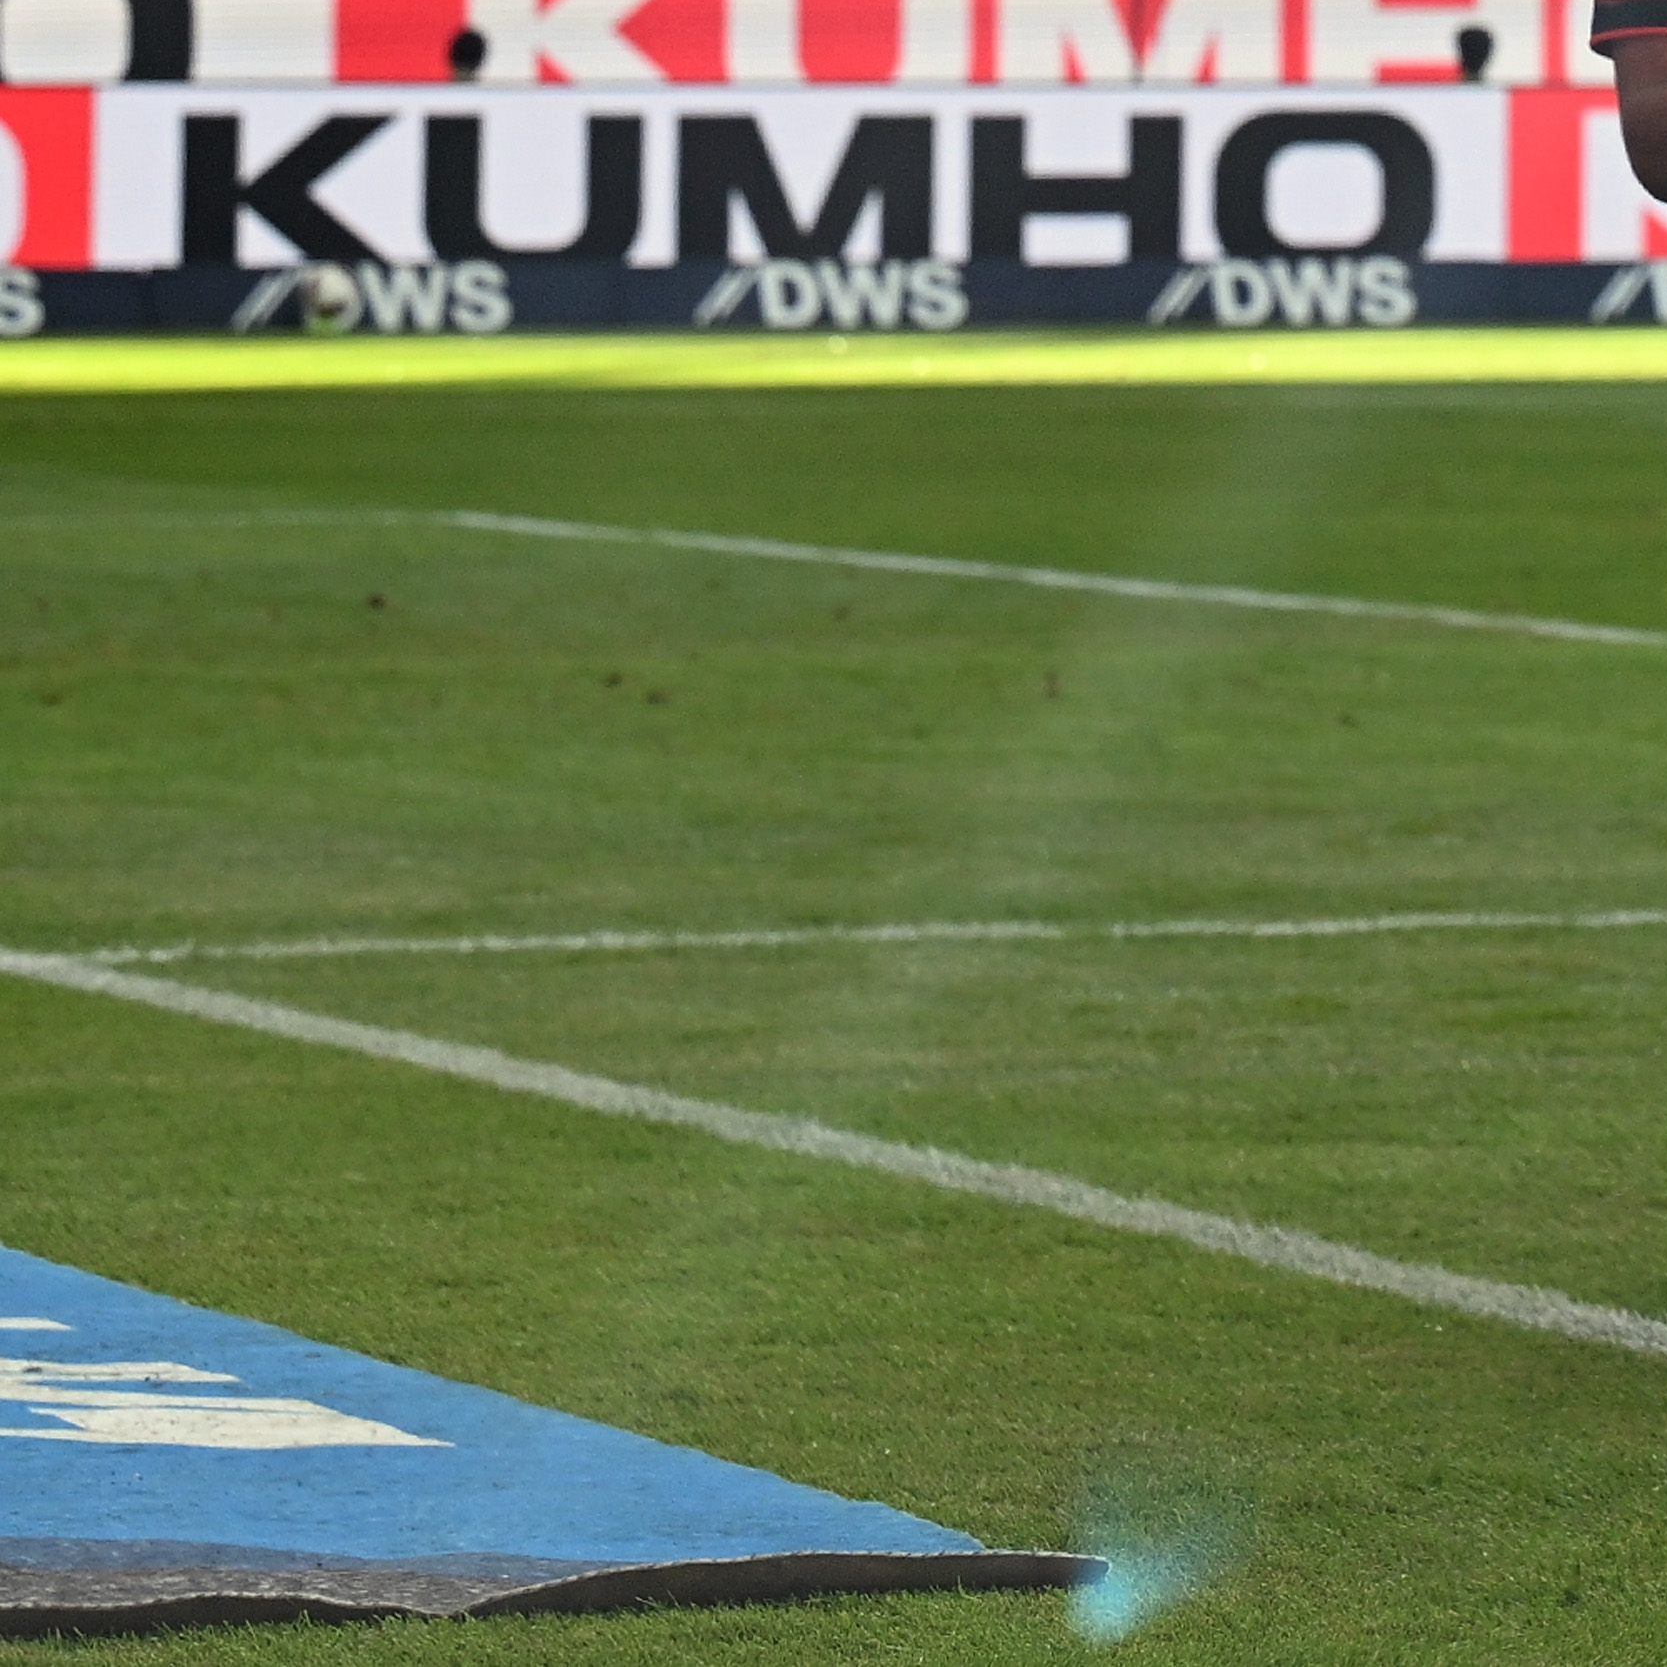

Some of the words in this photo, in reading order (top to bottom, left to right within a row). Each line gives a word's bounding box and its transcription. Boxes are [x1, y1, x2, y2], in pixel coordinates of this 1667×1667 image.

[182, 110, 1437, 265] KUMHO
[758, 258, 970, 332] DWS
[1205, 254, 1418, 328] DWS
